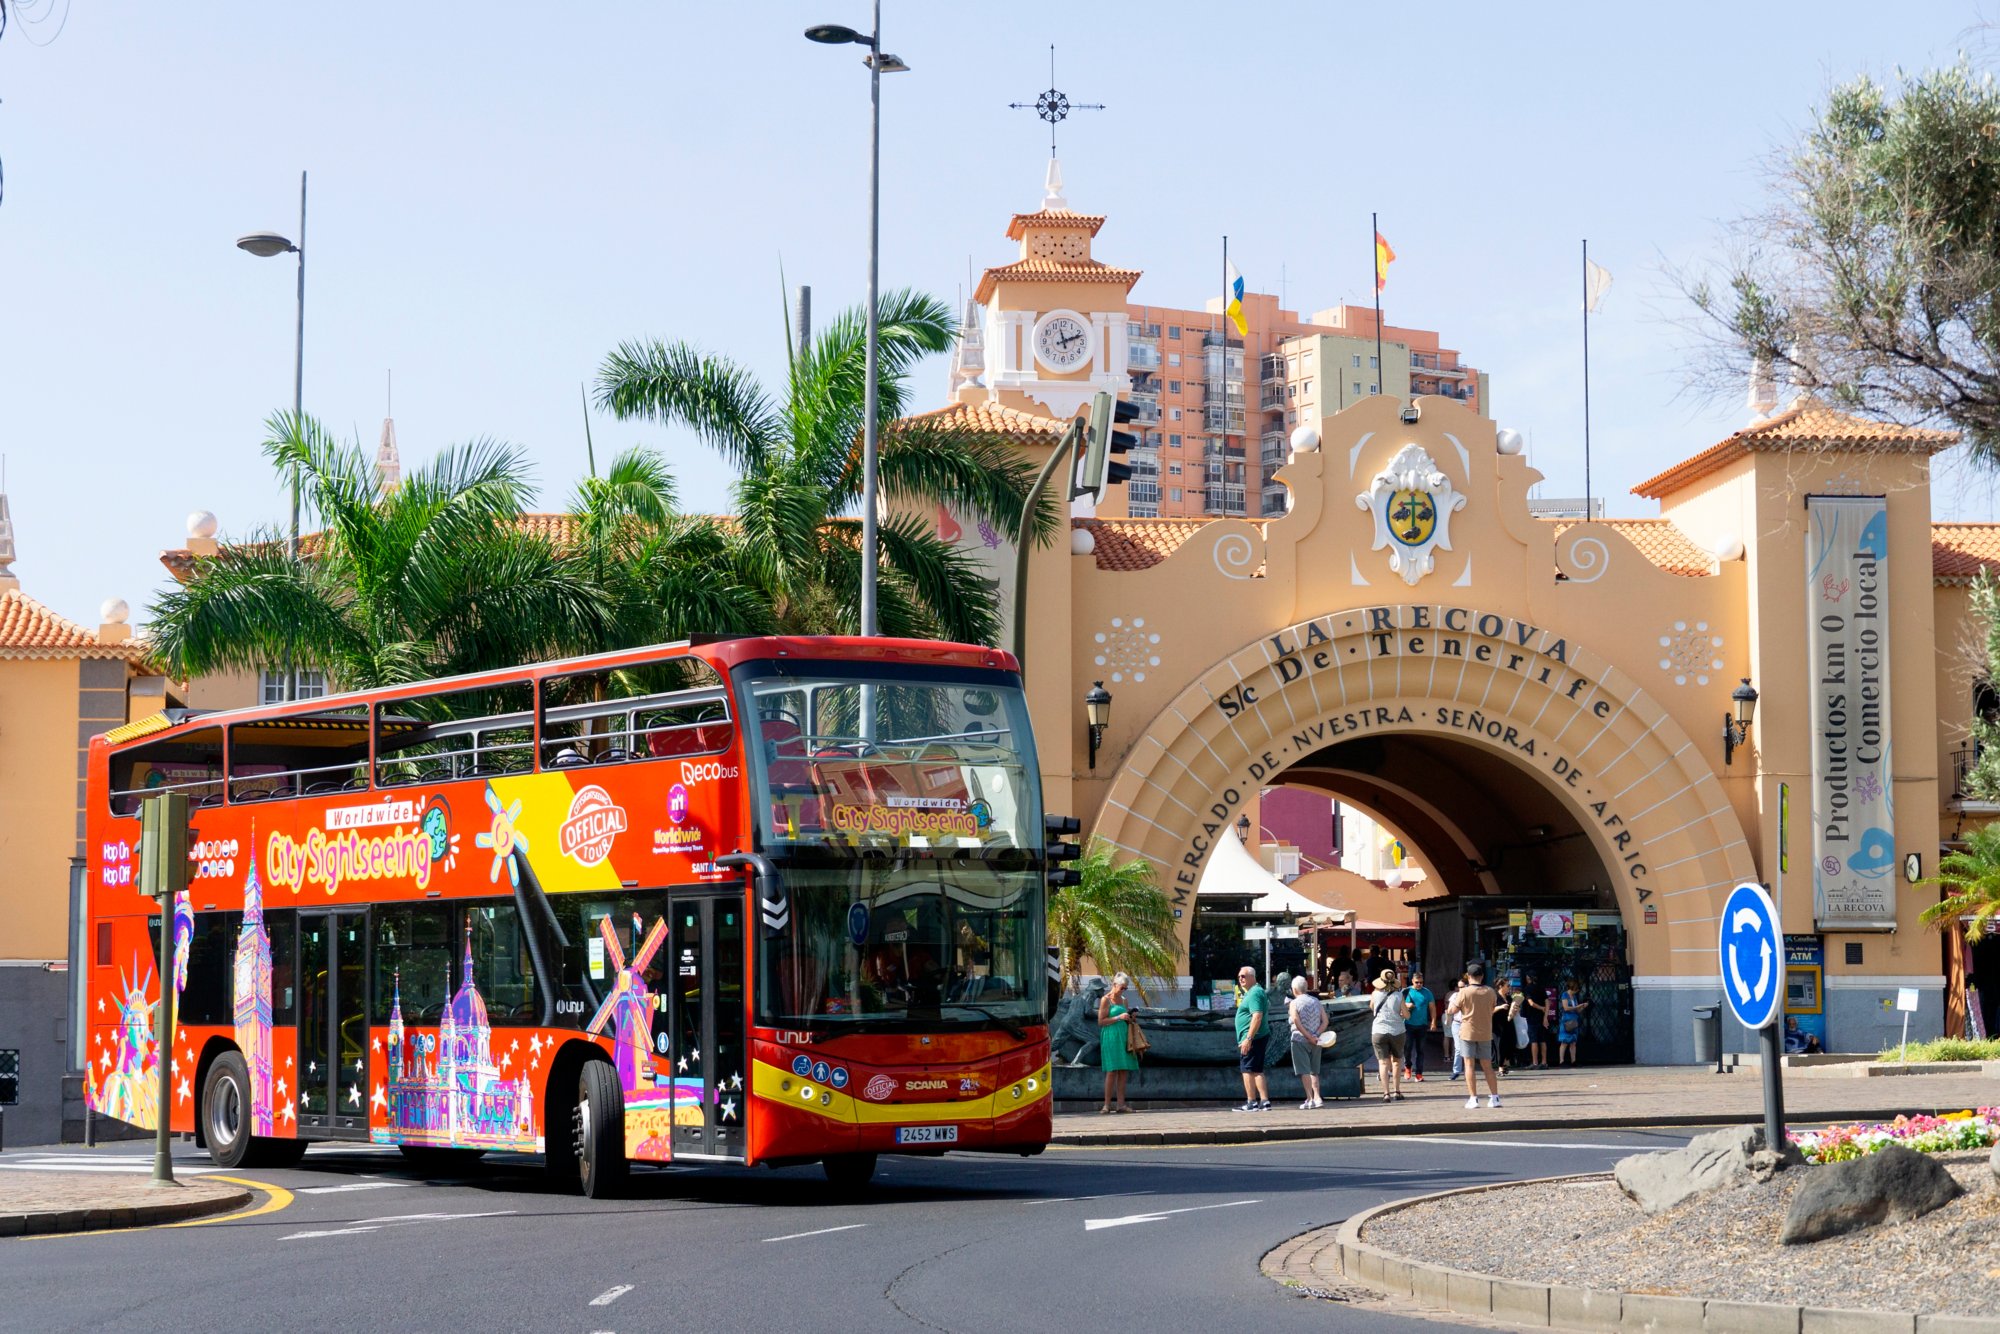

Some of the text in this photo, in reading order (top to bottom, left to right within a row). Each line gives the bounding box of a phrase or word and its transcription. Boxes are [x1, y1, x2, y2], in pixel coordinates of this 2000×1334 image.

[1270, 605, 1568, 665] LA RECOVA
[1821, 642, 1846, 685] km
[1852, 553, 1882, 765] Comercio local
[1218, 632, 1611, 719] S/c De Tenerife
[1824, 694, 1850, 843] Productos
[892, 798, 959, 808] Worldwide
[1170, 705, 1653, 907] MERCADO DE NVESTRA SEÑORA DE AFRICA
[333, 804, 410, 827] Worldwide
[565, 809, 624, 849] OFFICIAL
[654, 827, 701, 845] Worldwide
[103, 840, 130, 863] Hop On
[583, 838, 611, 861] TOUR
[103, 864, 132, 887] Hop Off
[1828, 903, 1886, 912] LA RECOVA
[1790, 952, 1812, 961] ATM
[867, 1081, 897, 1096] OFFICIAL
[905, 1080, 949, 1091] SCANIA
[903, 1127, 955, 1142] 2452 MWS
